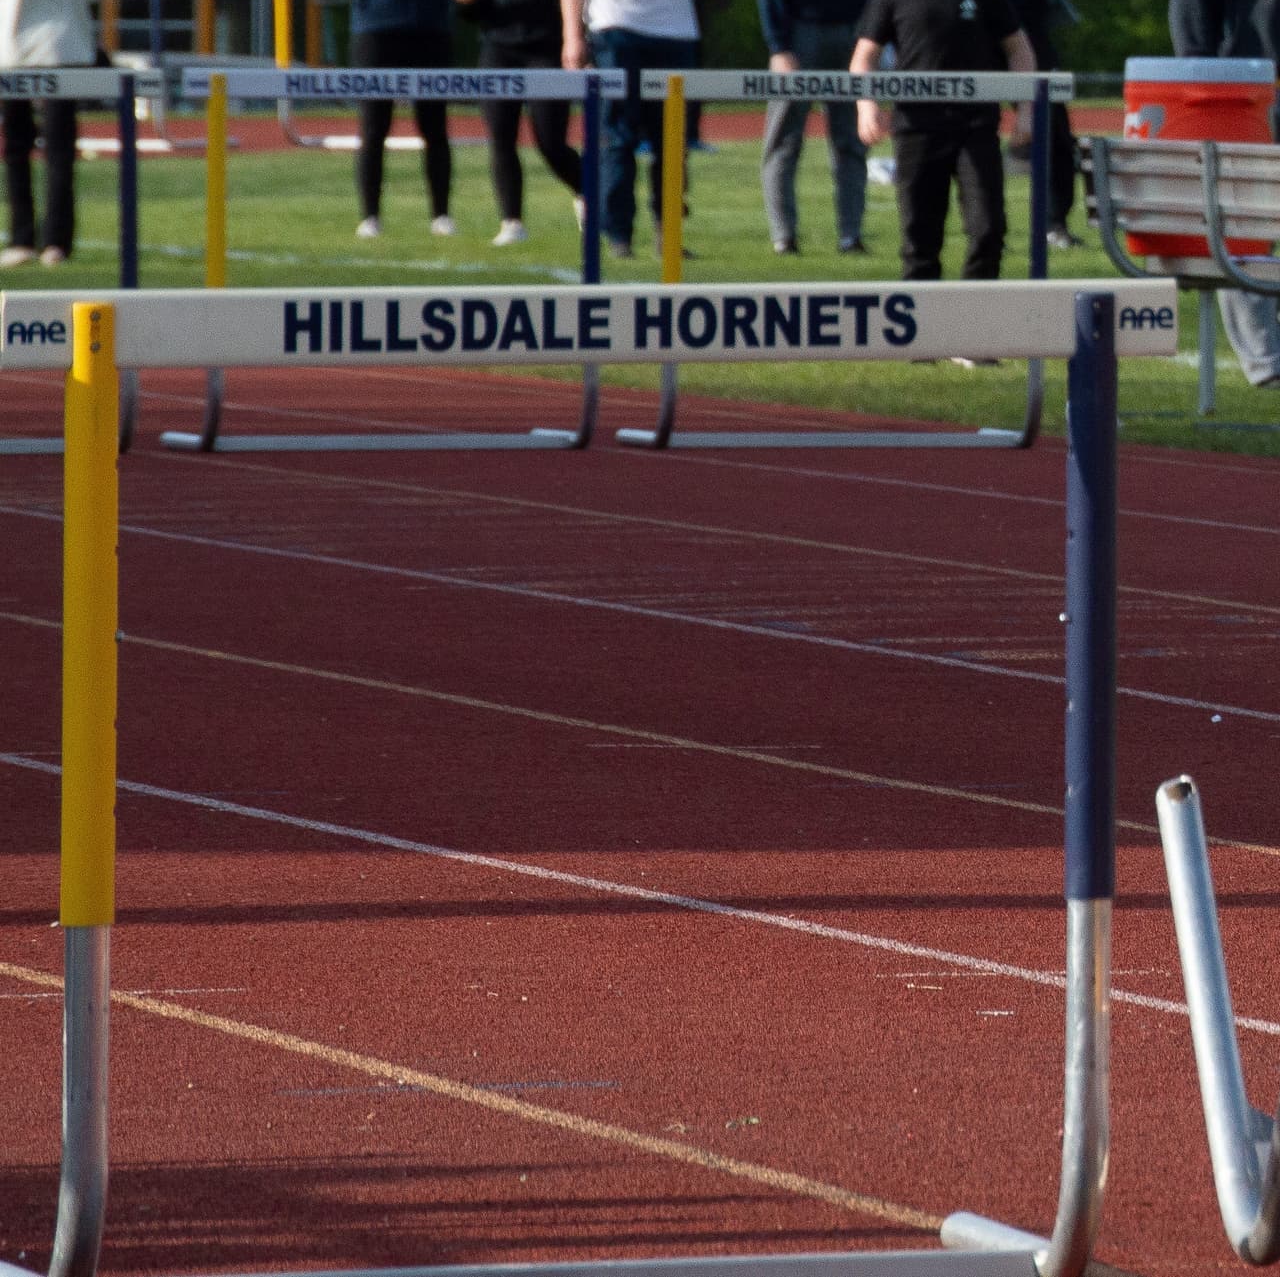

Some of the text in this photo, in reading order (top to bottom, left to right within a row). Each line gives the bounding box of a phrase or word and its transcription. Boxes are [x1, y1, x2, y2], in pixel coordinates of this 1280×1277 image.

[286, 74, 526, 95] HILLSDALE HORNETS
[742, 75, 977, 99] HILLSDALE HORNETS
[283, 293, 918, 354] HILLSDALE HORNETS
